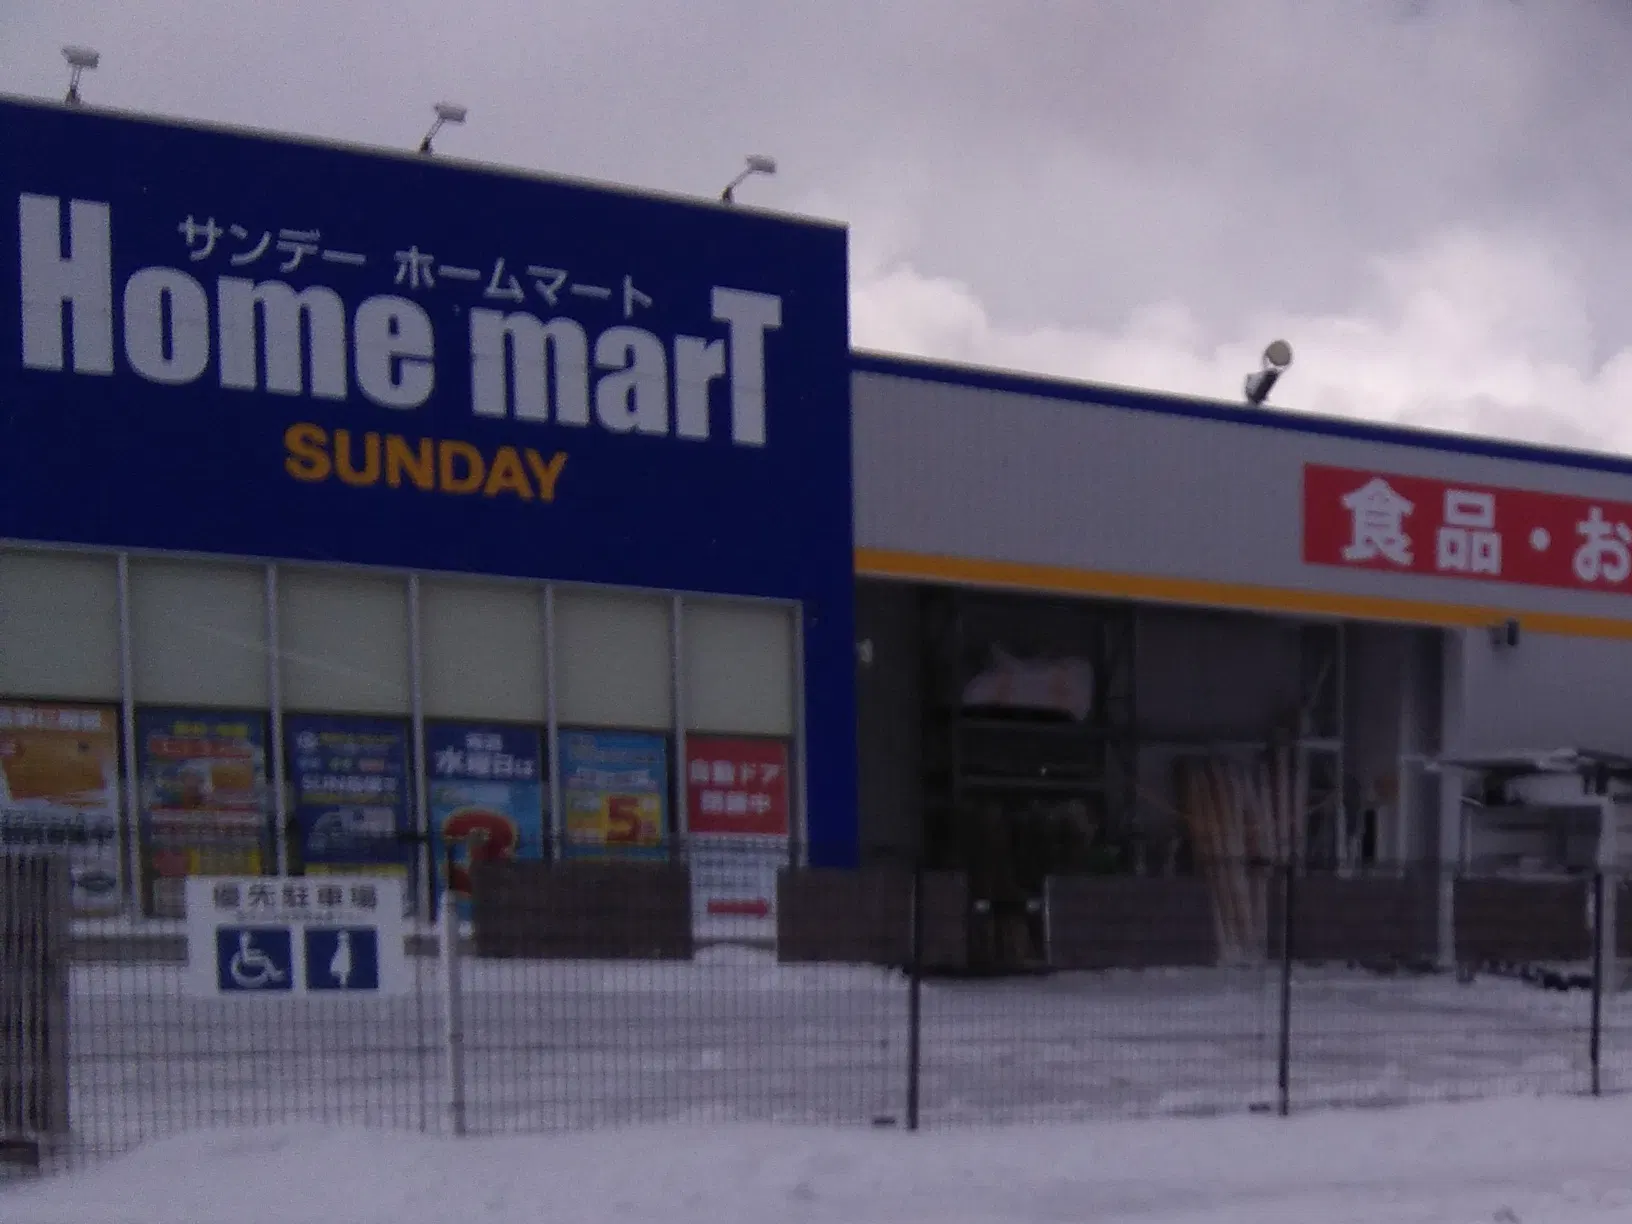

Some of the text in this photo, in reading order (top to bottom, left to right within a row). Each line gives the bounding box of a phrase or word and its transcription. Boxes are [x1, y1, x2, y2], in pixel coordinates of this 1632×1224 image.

[19, 192, 436, 409] Home
[178, 213, 654, 317] サンデー ホームマート
[283, 422, 568, 502] SUNDAY
